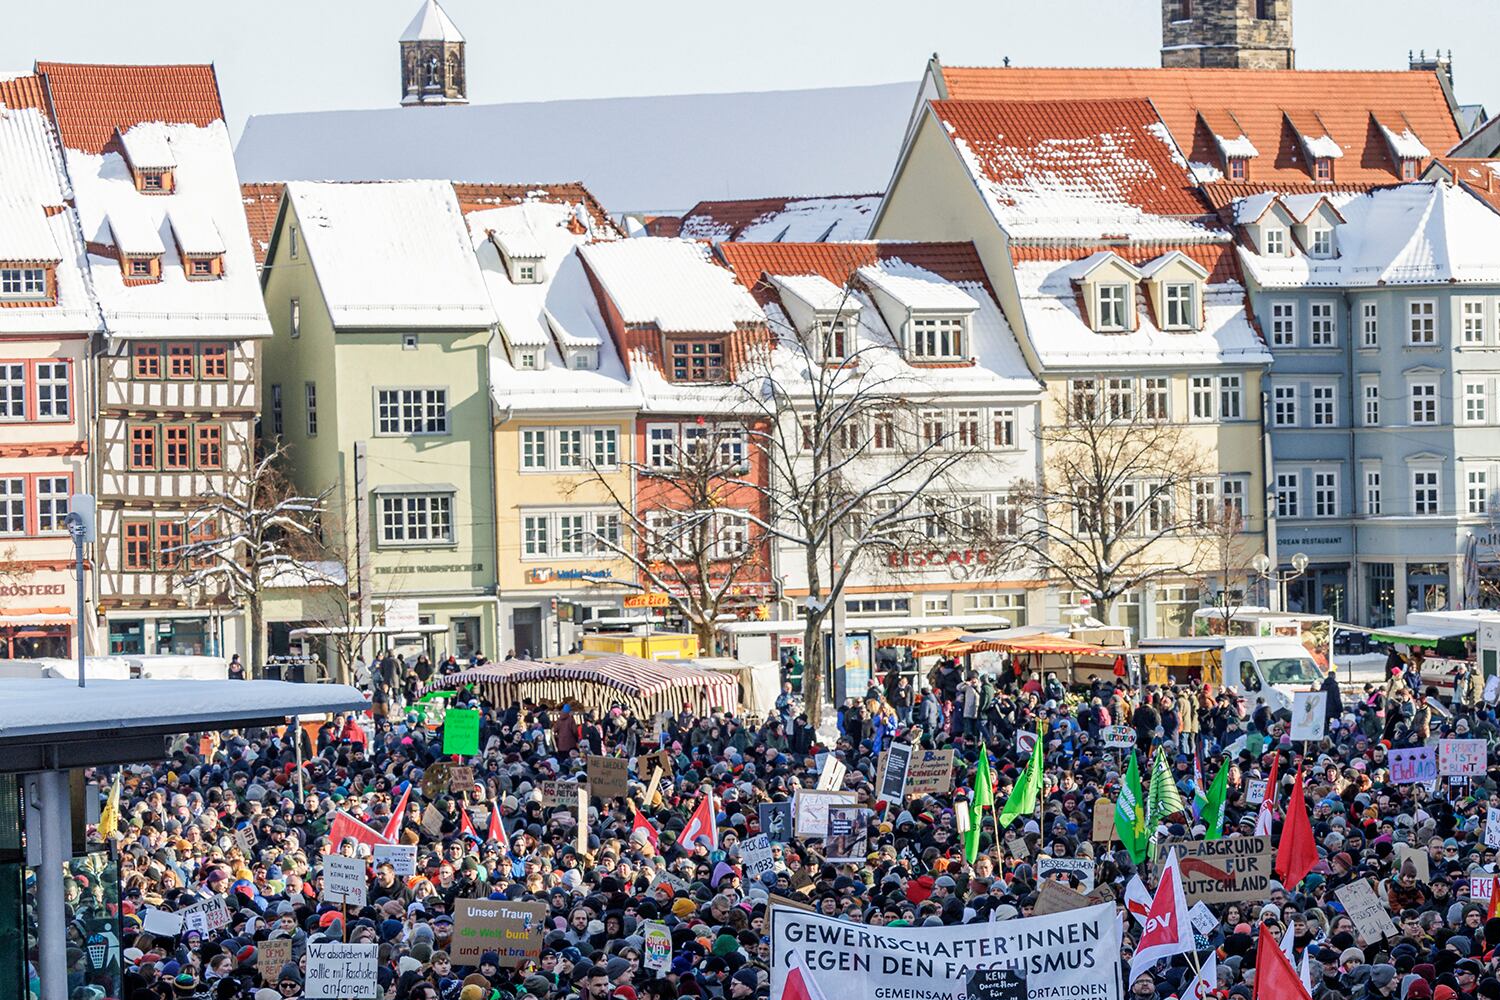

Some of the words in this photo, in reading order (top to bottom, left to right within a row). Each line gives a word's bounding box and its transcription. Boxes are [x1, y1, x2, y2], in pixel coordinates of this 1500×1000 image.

[1301, 537, 1342, 545] RESTAURANT
[1226, 858, 1258, 873] FÜR
[467, 907, 498, 918] Unser
[500, 907, 533, 920] Traum
[461, 929, 476, 938] die
[505, 929, 530, 941] bunt
[309, 945, 327, 960] Wer
[328, 945, 363, 961] abschieben
[364, 944, 378, 959] will
[459, 947, 480, 957] und
[309, 962, 331, 980] sollte
[882, 954, 933, 978] DEN
[985, 972, 1008, 981] KEIN
[1028, 983, 1108, 999] ORTATIONEN
